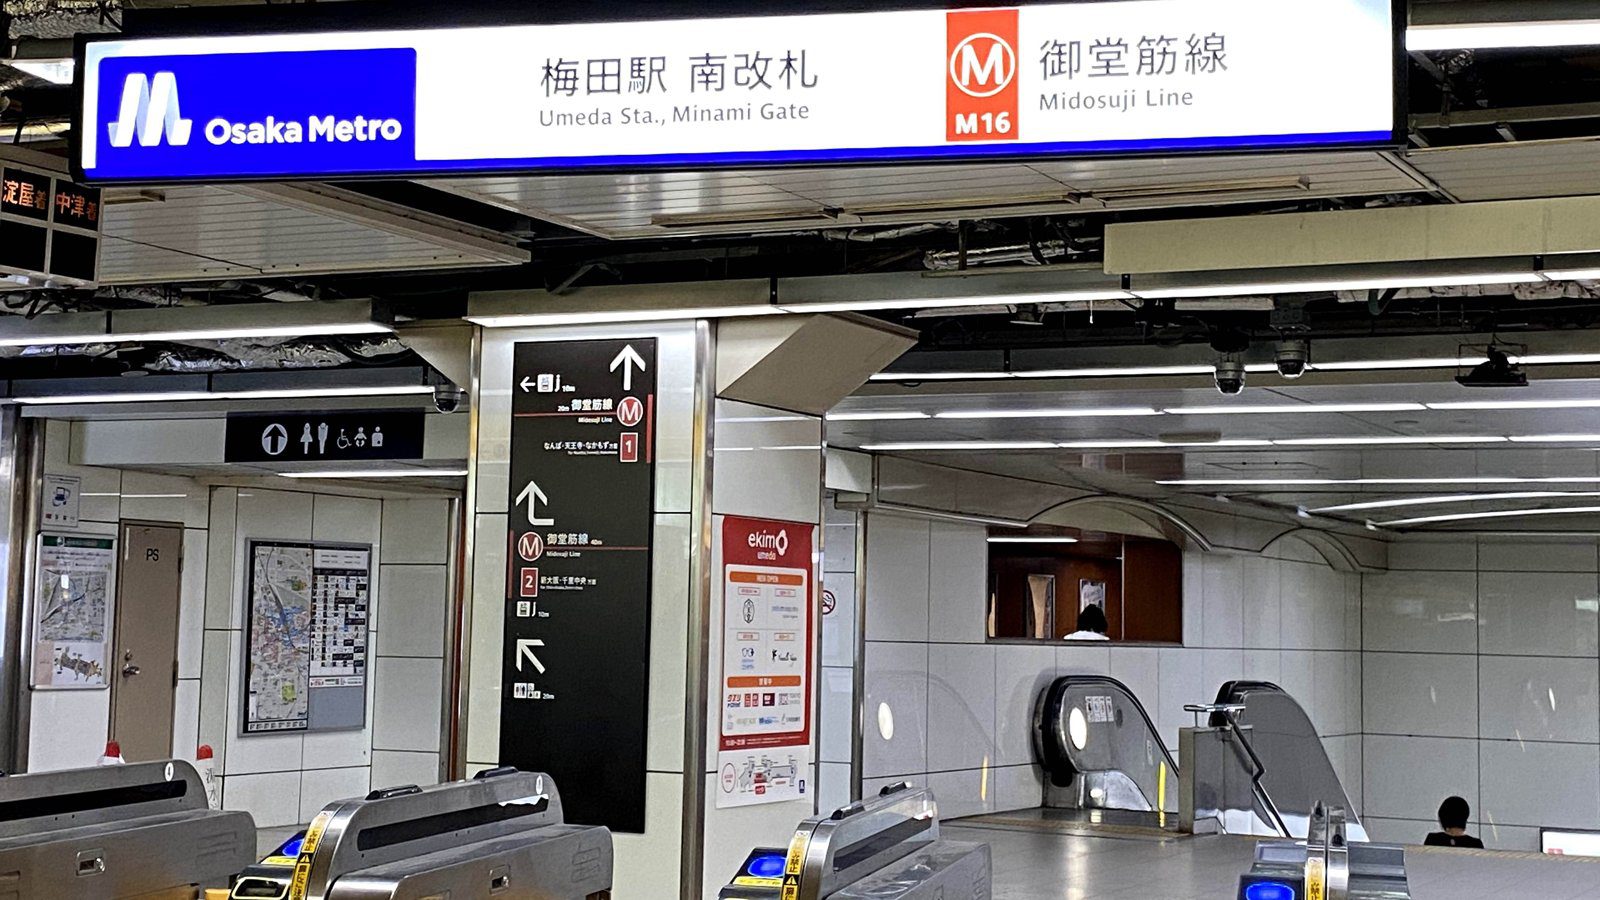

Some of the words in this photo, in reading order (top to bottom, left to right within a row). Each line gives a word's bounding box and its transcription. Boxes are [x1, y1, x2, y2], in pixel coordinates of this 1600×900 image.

[1039, 32, 1228, 81] 御堂筋線
[541, 55, 667, 98] 梅田駅
[689, 49, 818, 92] 南改札
[1040, 90, 1137, 113] Midosuji
[1146, 87, 1193, 107] Line
[540, 108, 612, 127] Umeda
[621, 107, 667, 127] Sta.,
[673, 103, 751, 122] Minami
[760, 101, 809, 121] Gate
[205, 116, 302, 146] Osaka
[309, 113, 402, 143] Metro
[625, 440, 632, 453] 1
[547, 533, 588, 545] 御堂筋線
[146, 548, 160, 562] PS
[525, 575, 533, 589] 2
